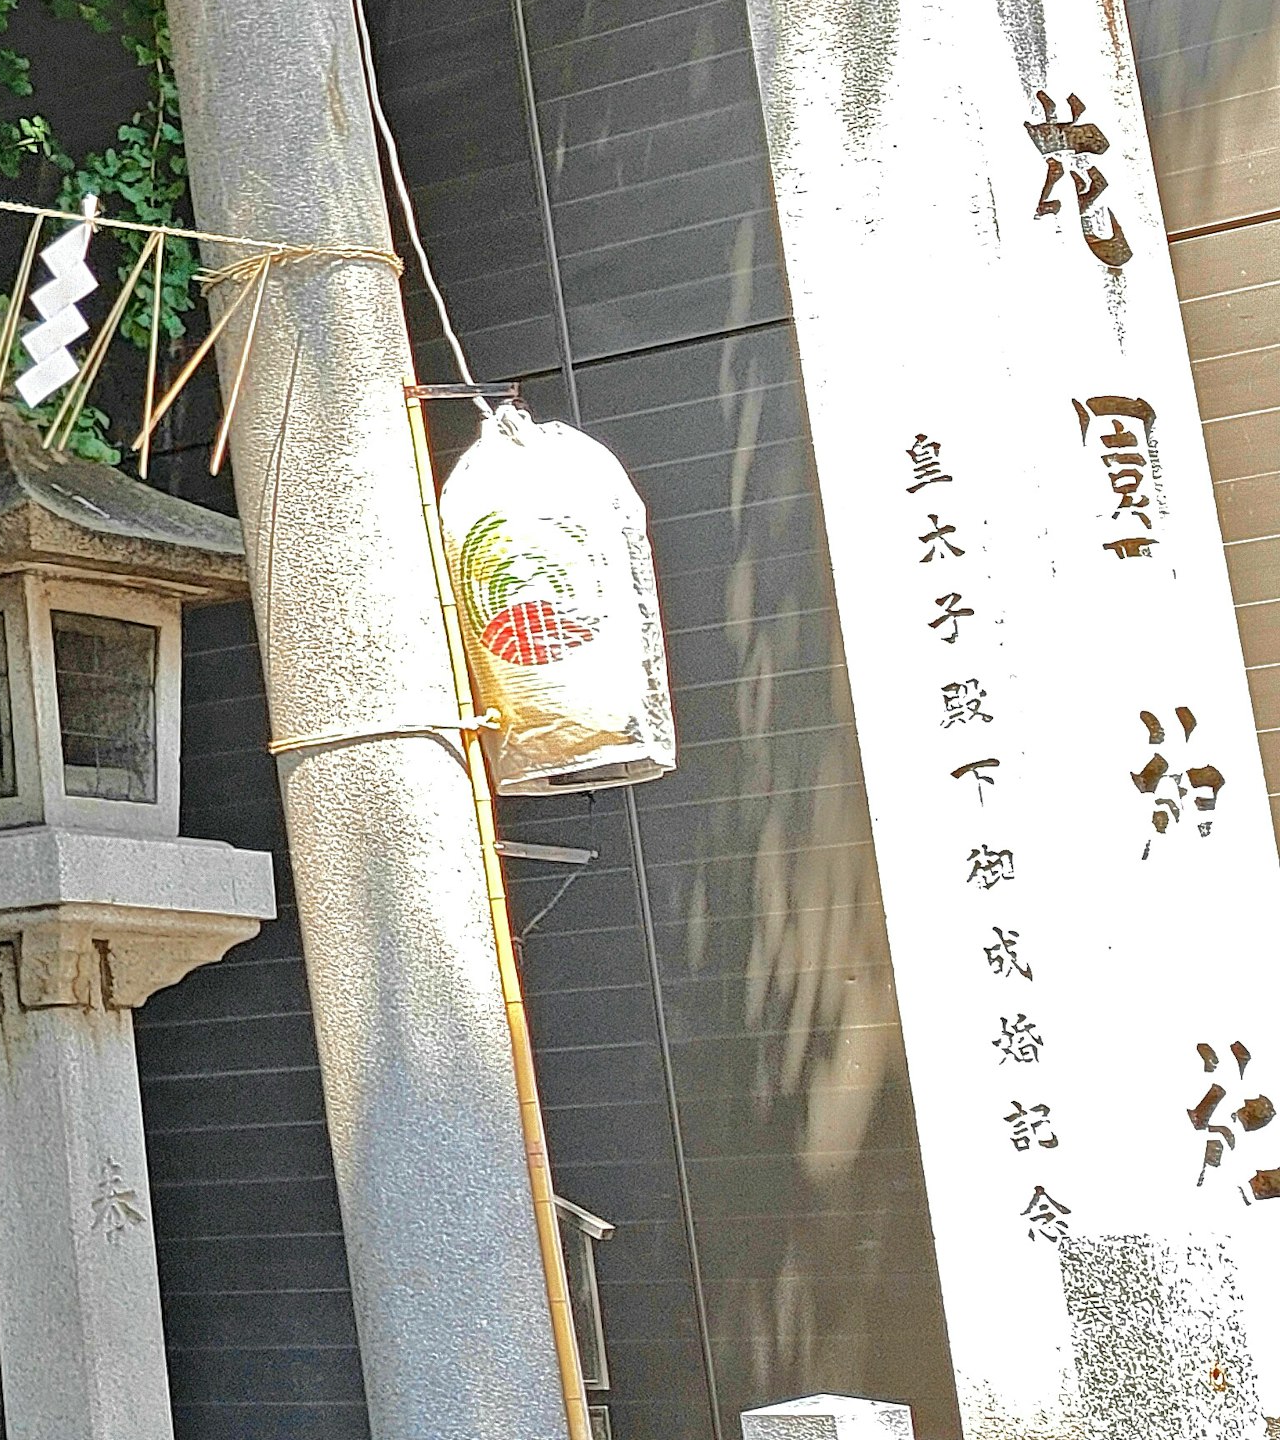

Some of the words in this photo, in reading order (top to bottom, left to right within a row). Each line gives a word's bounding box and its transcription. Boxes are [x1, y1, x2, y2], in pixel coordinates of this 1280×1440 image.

[905, 433, 1071, 1243] 皇太子殿下御成婚記念
